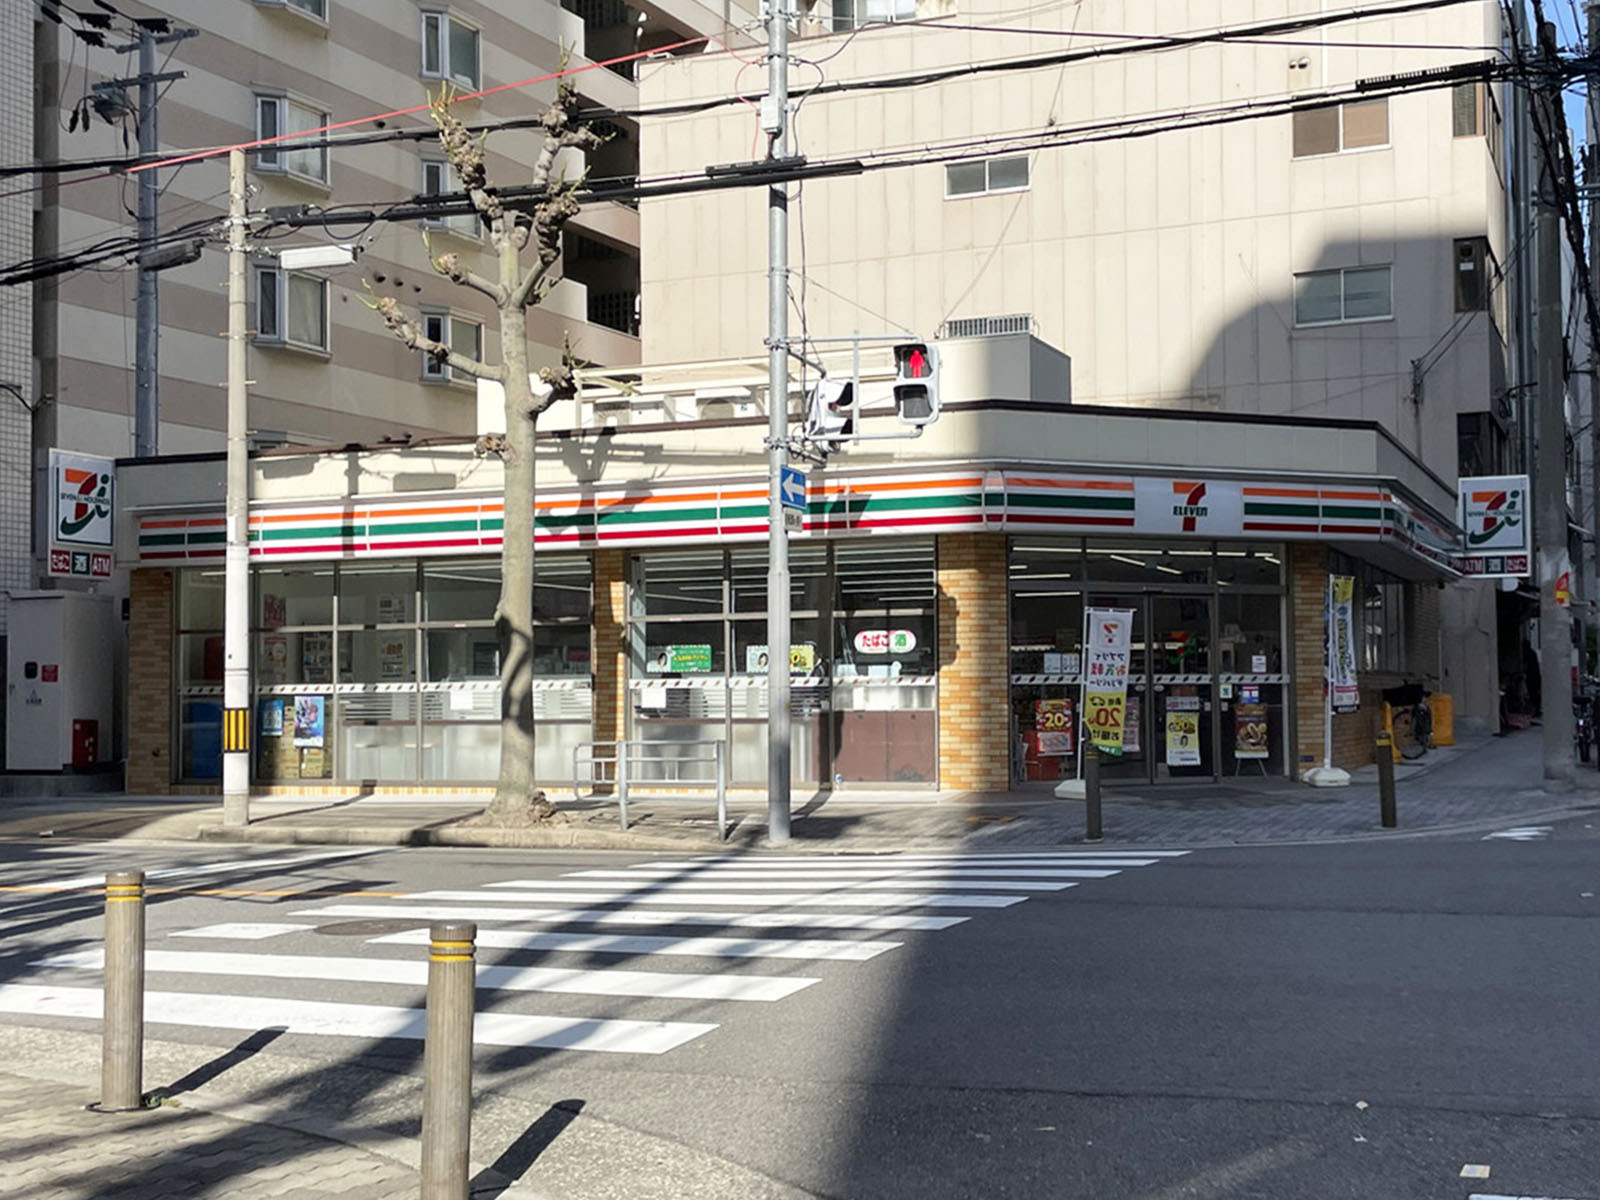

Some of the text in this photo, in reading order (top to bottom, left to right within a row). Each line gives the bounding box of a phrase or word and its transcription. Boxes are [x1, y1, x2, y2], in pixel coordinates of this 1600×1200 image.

[1173, 482, 1206, 531] 7
[93, 557, 110, 572] ATM
[862, 634, 889, 647] たばこ
[895, 634, 907, 647] 酒
